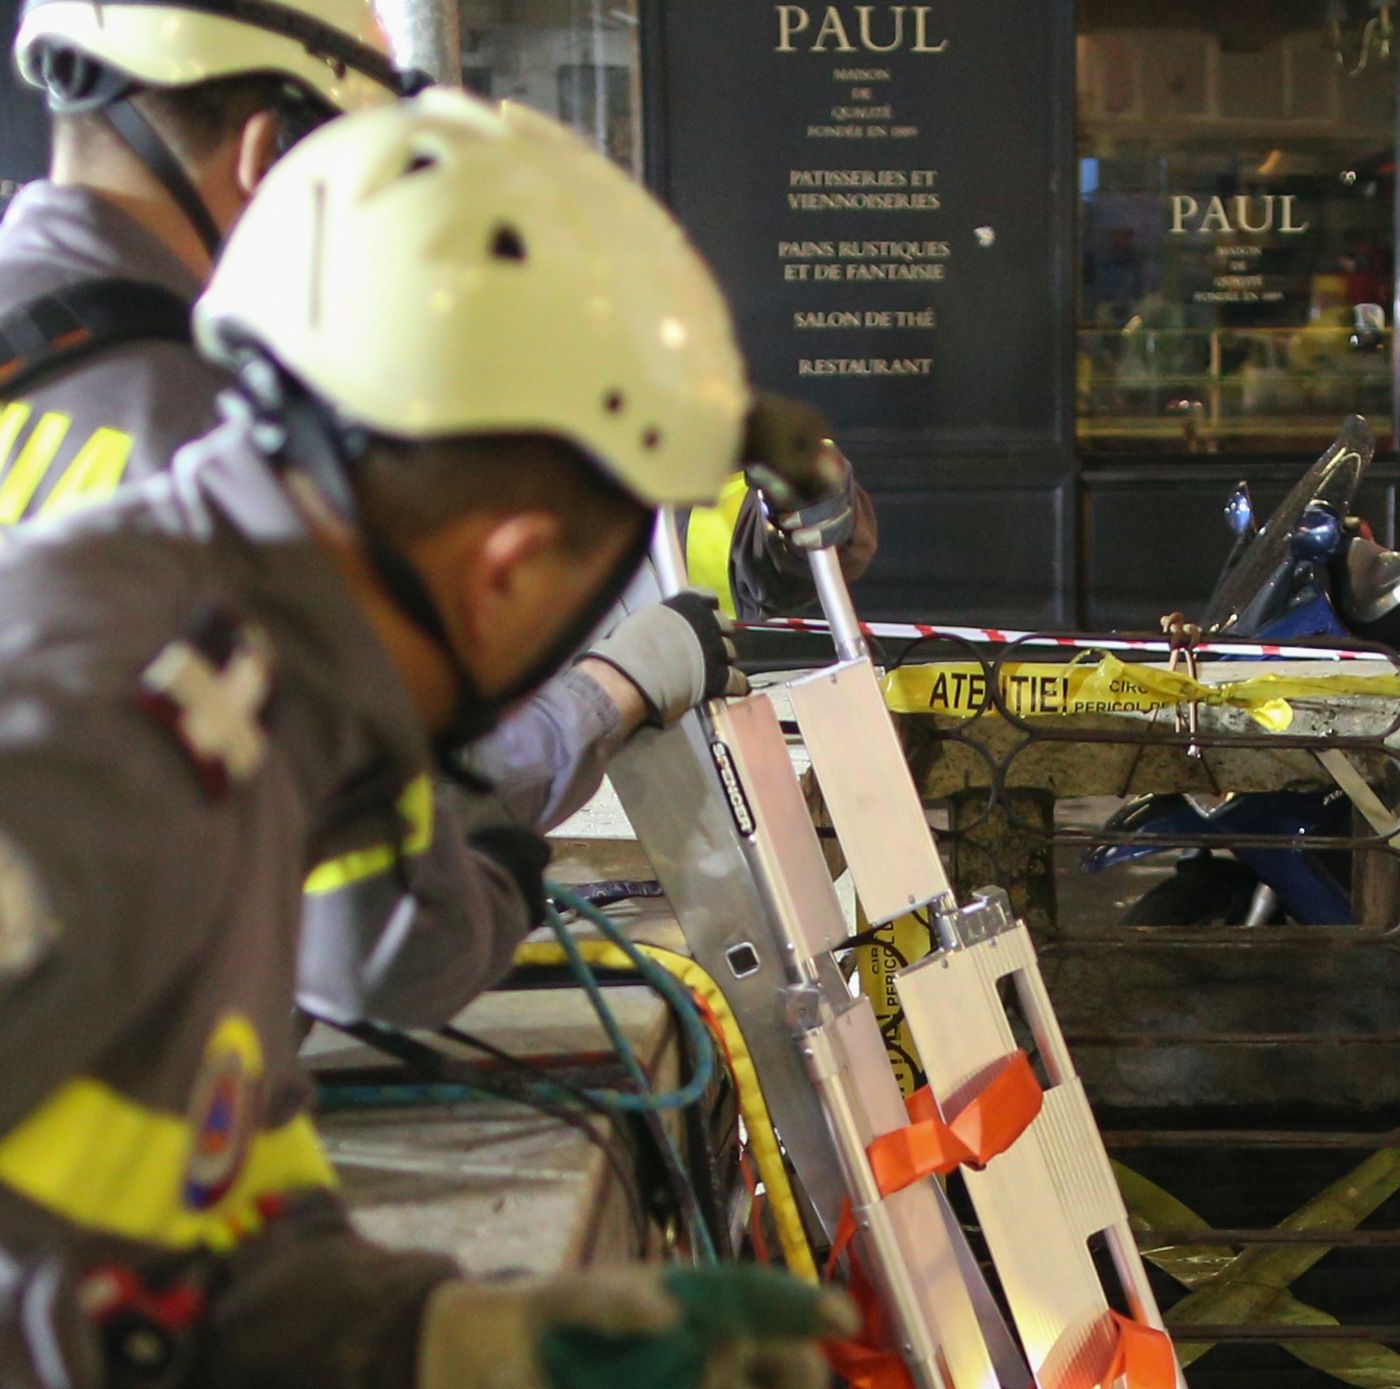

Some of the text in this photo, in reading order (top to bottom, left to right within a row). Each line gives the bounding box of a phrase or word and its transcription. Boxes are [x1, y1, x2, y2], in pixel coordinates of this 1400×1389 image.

[774, 5, 950, 51] PAUL
[790, 170, 938, 187] PATISSERIES ET
[788, 193, 941, 210] VIENNOISERIES
[1168, 194, 1310, 234] PAUL
[778, 241, 951, 262] PAINS RUSTIQUES
[784, 264, 944, 280] ET DE FANTAISIE
[793, 307, 935, 328] SALON DE THÉ
[798, 358, 934, 375] RESTAURANT
[712, 742, 752, 832] SPENCER
